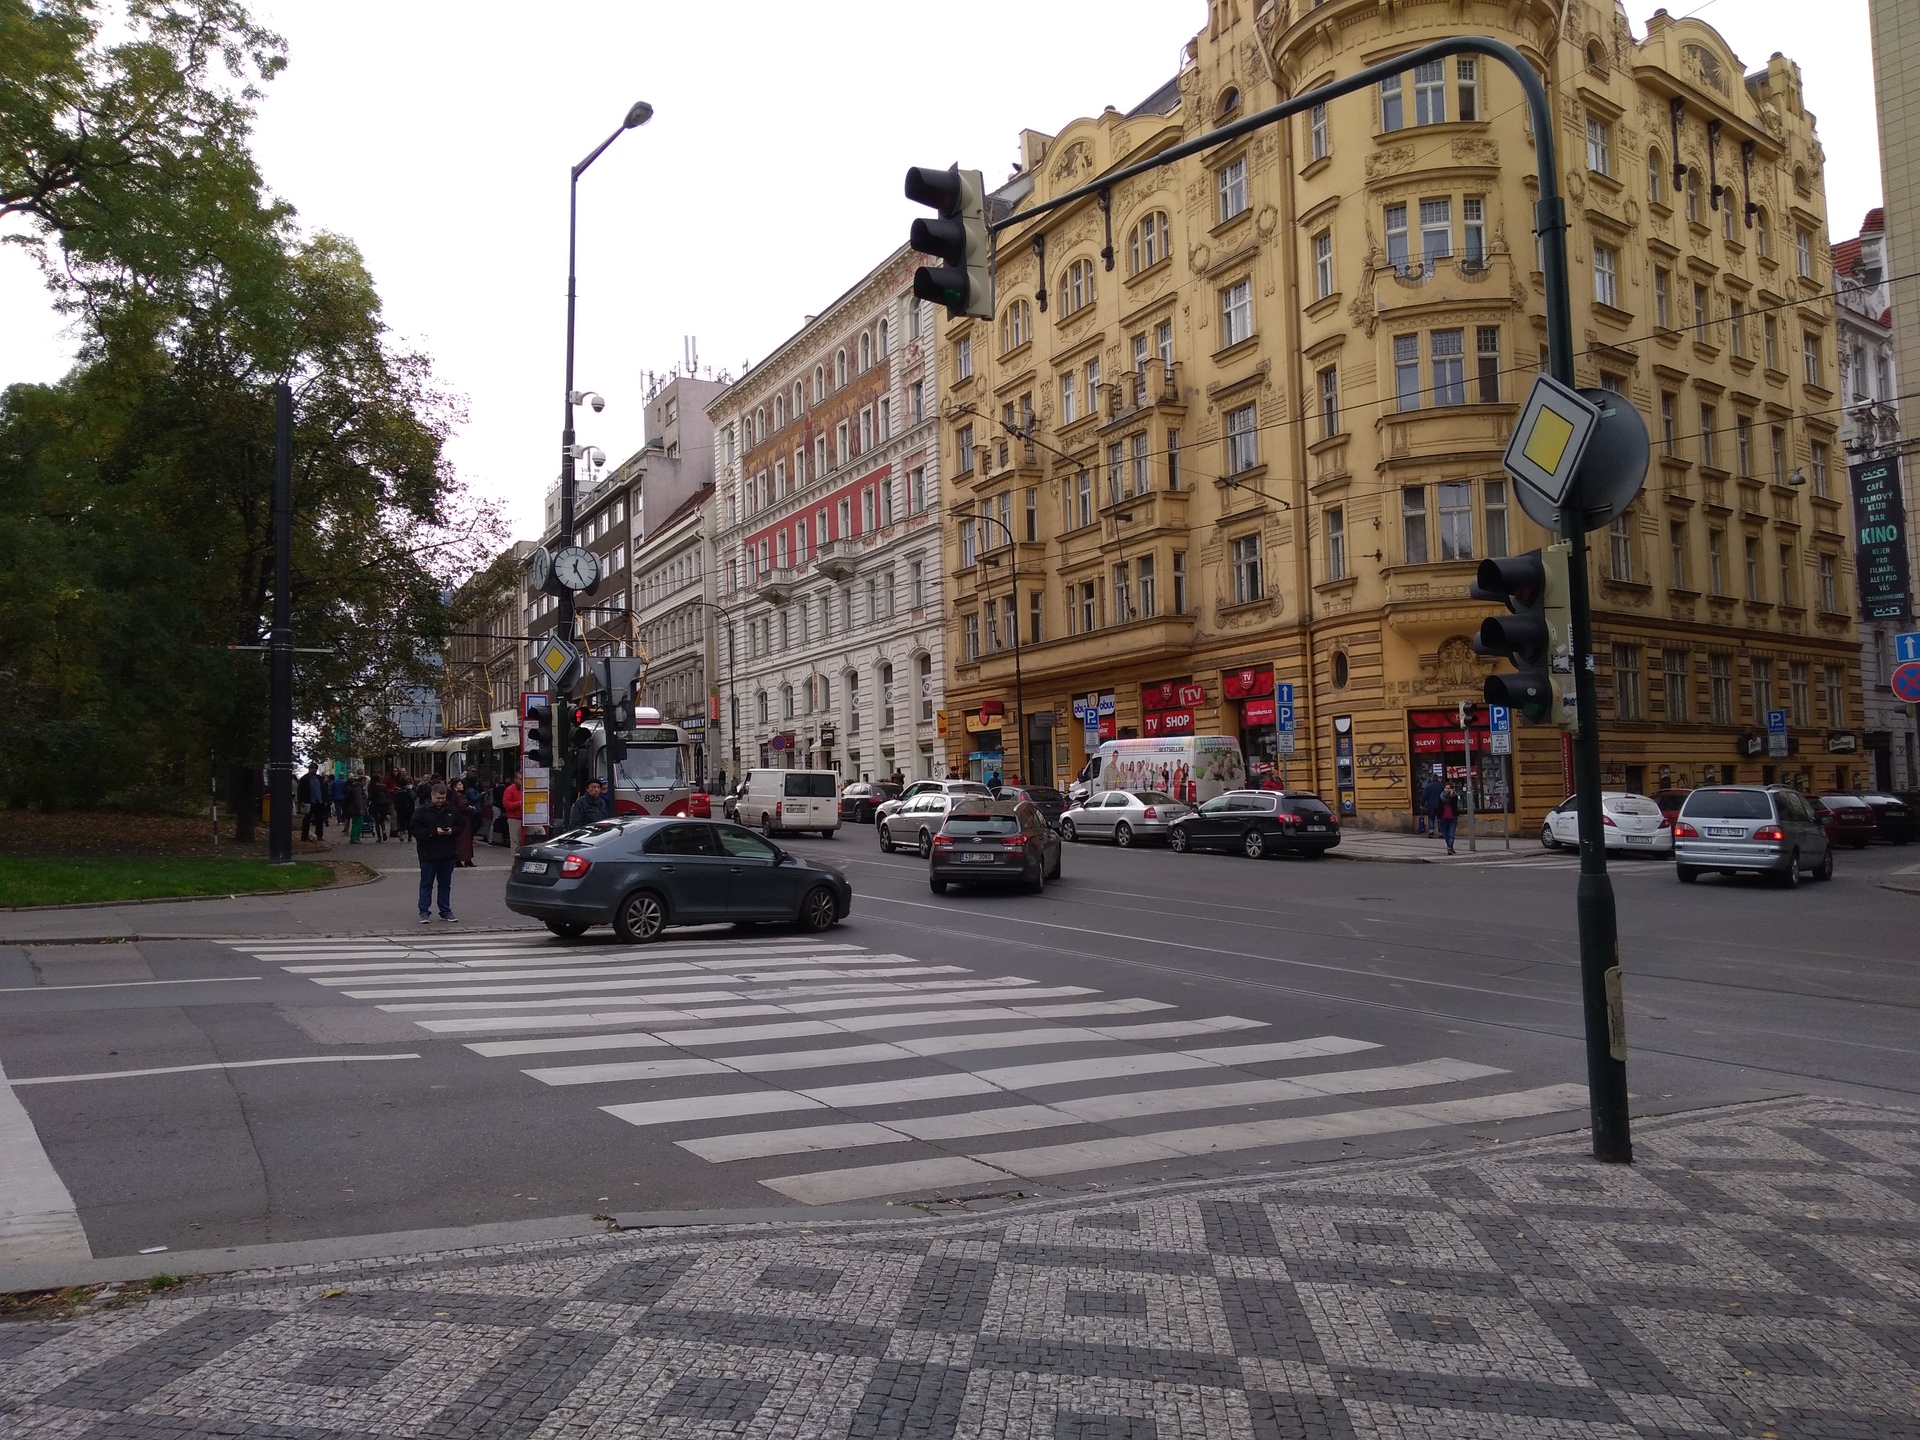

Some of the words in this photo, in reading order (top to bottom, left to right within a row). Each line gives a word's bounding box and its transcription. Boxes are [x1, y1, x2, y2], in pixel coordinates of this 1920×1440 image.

[1866, 480, 1883, 491] CAFÉ
[1860, 491, 1893, 504] FILMOVÝ
[1867, 502, 1886, 511] KLUB
[1869, 513, 1885, 522] BAR
[1861, 524, 1897, 545] KINO
[1243, 673, 1252, 681] TV
[1185, 688, 1201, 701] TV
[1494, 707, 1504, 724] P
[1146, 719, 1157, 730] TV
[1166, 715, 1190, 728] SHOP
[644, 794, 665, 802] 8257
